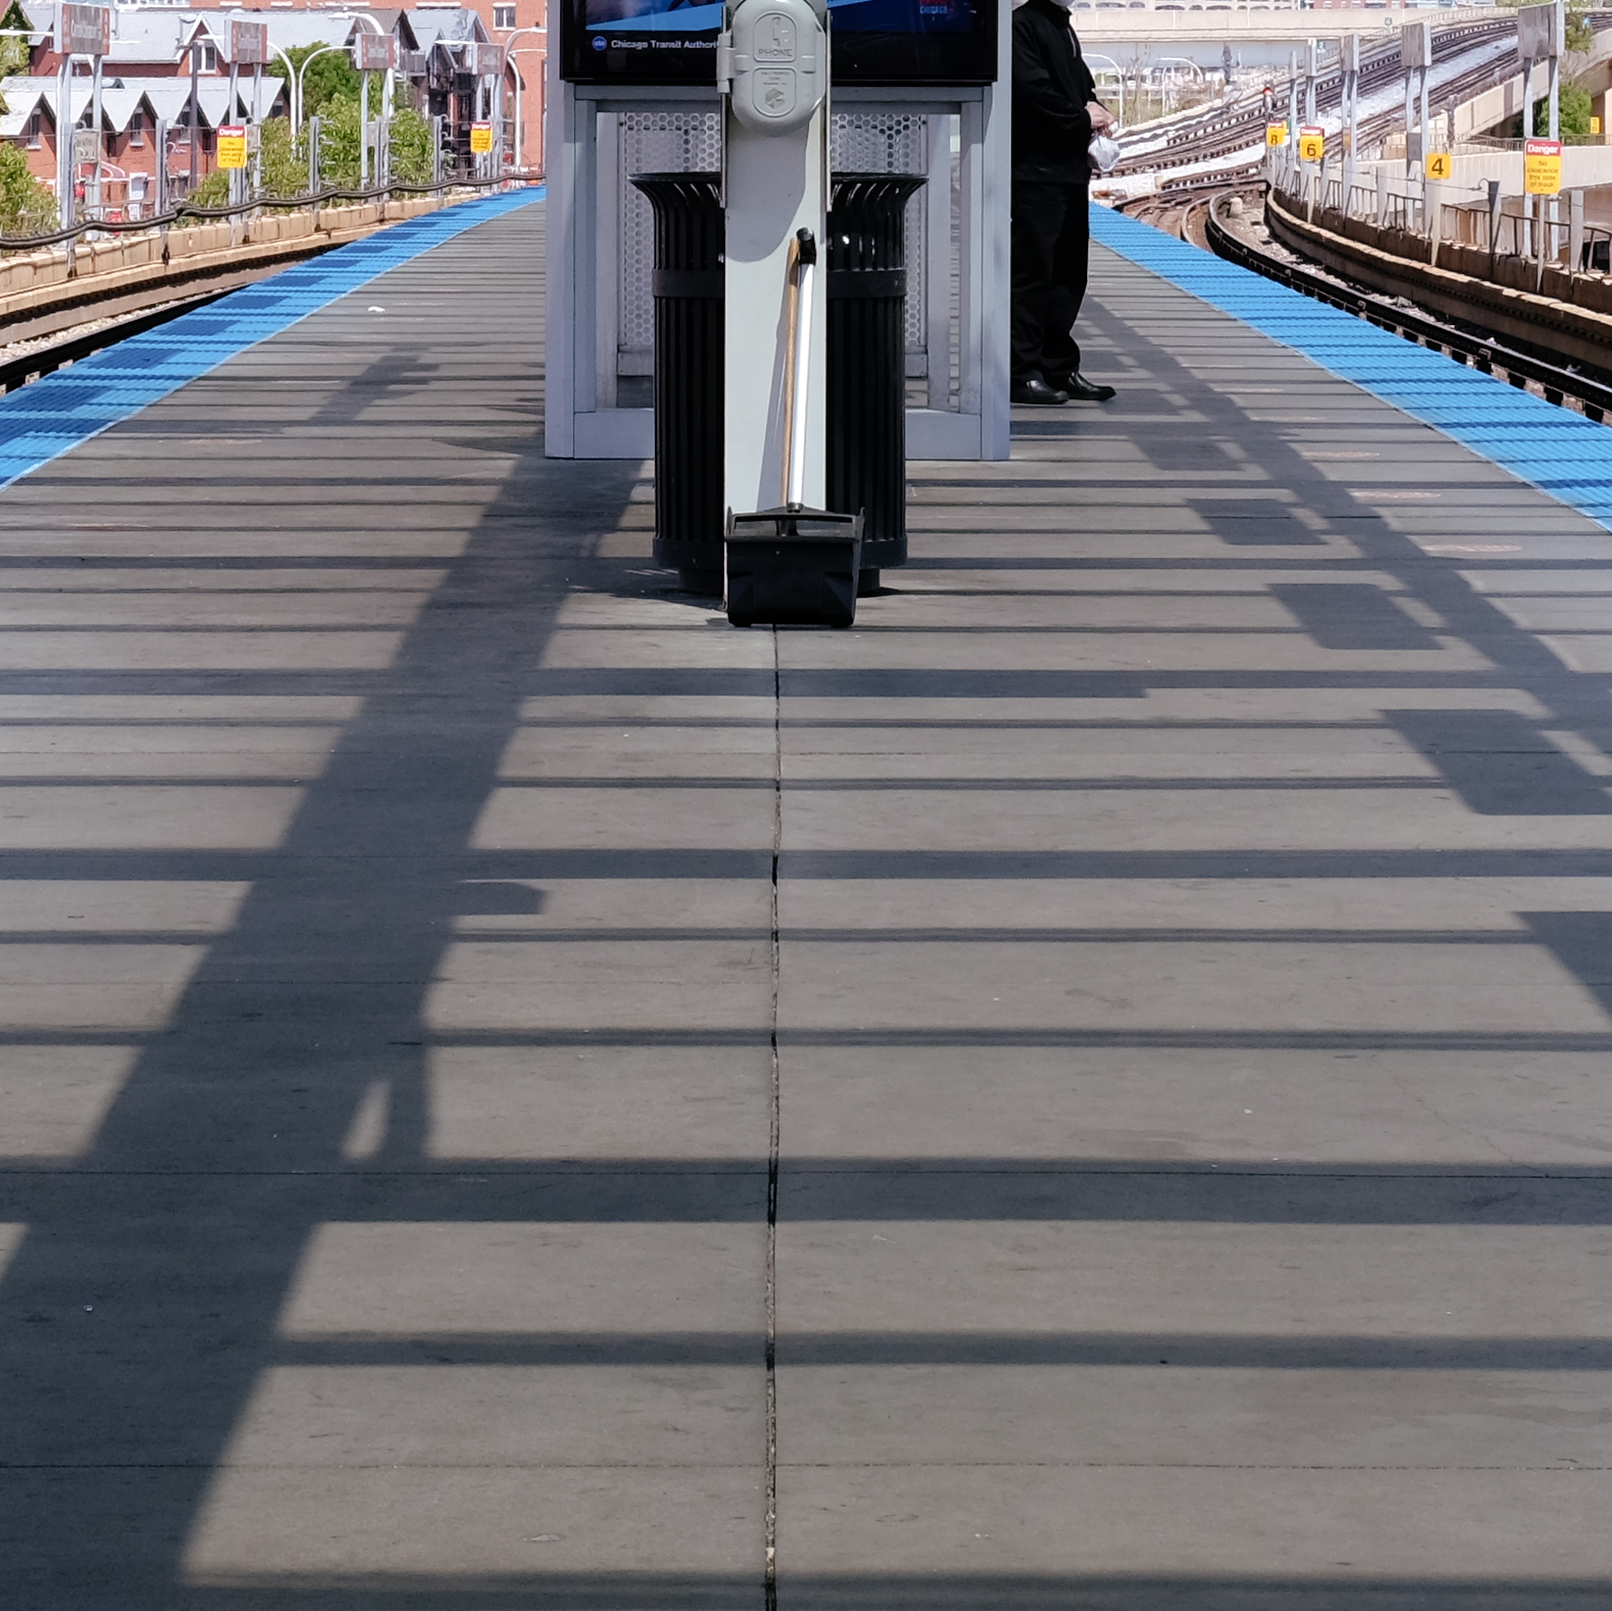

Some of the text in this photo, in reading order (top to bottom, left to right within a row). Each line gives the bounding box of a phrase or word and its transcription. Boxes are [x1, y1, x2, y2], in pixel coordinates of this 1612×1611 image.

[611, 39, 648, 50] Chicago
[650, 39, 682, 49] Transit
[684, 39, 717, 49] Authori
[758, 48, 793, 57] PHONE
[1306, 143, 1317, 157] 6
[1527, 143, 1559, 155] Danger
[1431, 157, 1444, 175] 4
